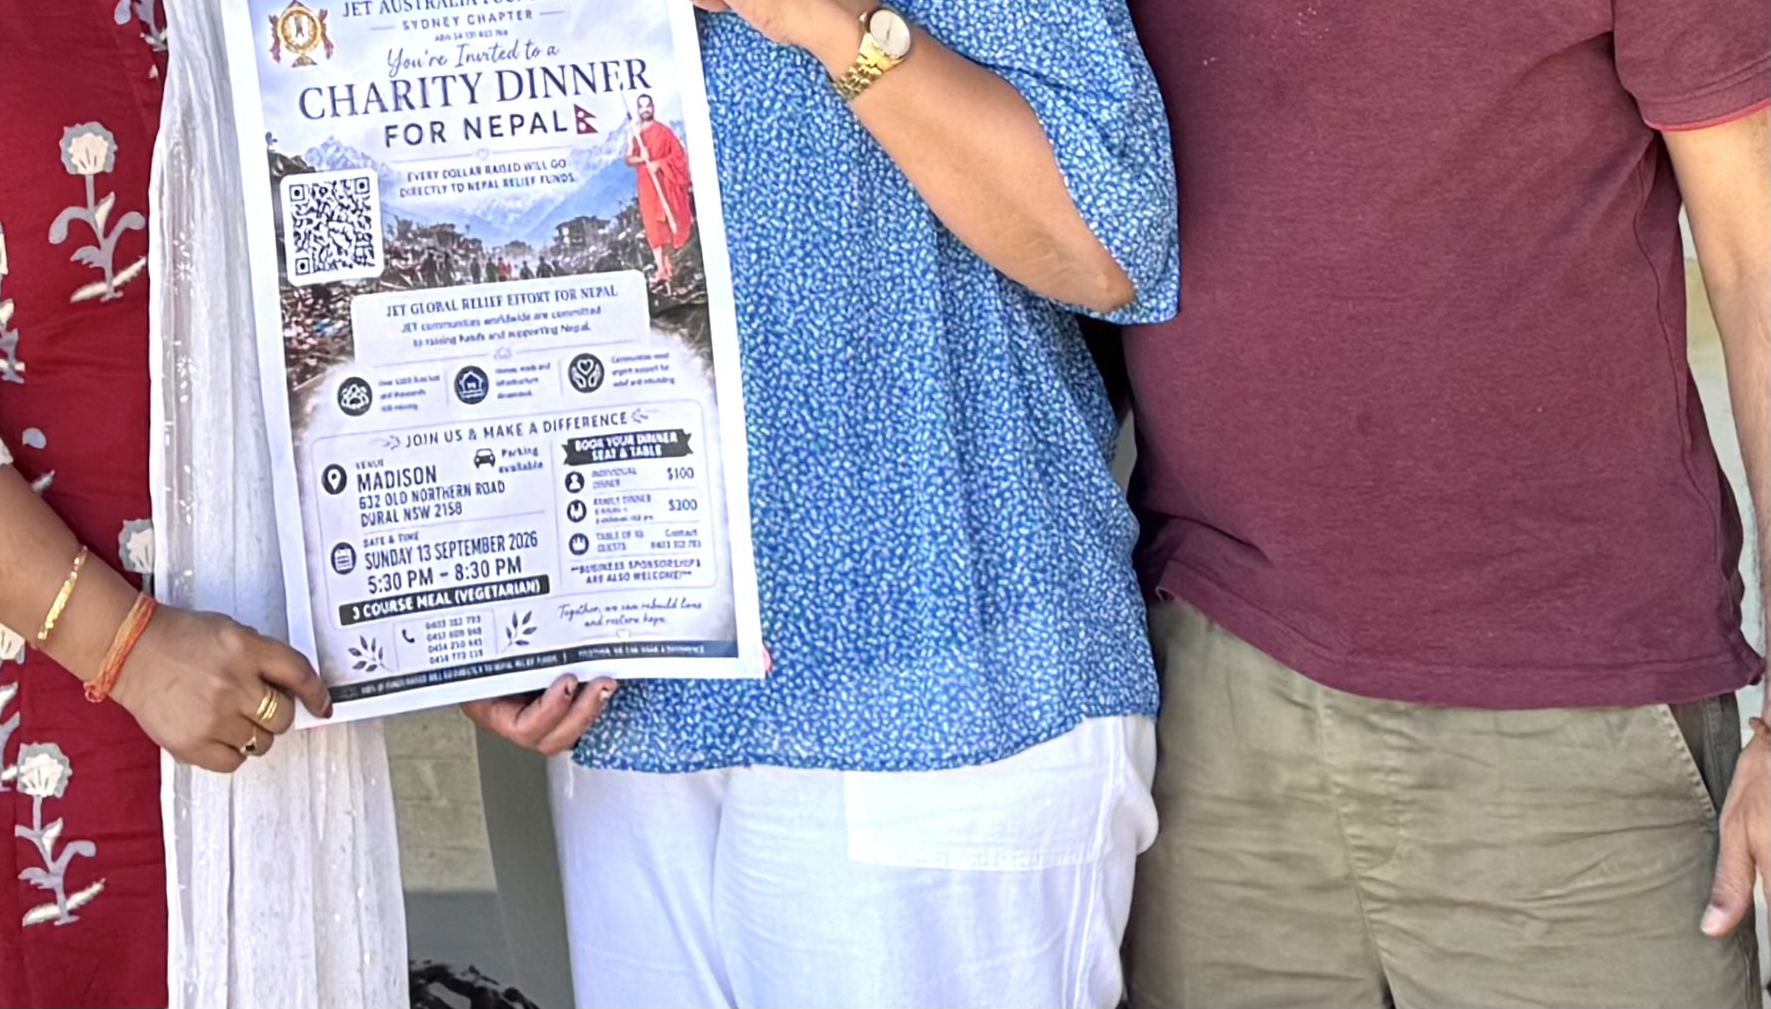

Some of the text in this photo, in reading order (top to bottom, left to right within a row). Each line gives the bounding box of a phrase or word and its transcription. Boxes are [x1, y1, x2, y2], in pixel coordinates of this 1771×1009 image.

[342, 0, 373, 18] JET
[402, 9, 533, 31] SYDNEY CHAPTER
[387, 38, 560, 77] You're Invited to a
[298, 58, 653, 121] CHARITY DINNER
[385, 109, 569, 148] FOR NEPAL
[407, 158, 566, 183] EVERY DOLLAR RAISED WILL GO
[400, 184, 448, 199] DIRECTLY
[451, 182, 463, 194] TO
[467, 178, 500, 193] NEPAL
[502, 175, 536, 189] RELIEF
[386, 285, 617, 318] JET GLOBAL RELIEF EFFORT FOR NEPAL
[406, 411, 628, 448] JOIN US & MAKE A DIFFERENCE
[502, 447, 539, 459] Parking
[357, 465, 438, 493] MADISON
[667, 467, 694, 480] $100
[359, 480, 505, 509] 632 OLD NORTHERN ROAD
[360, 501, 463, 528] DURAL NSW 2158
[365, 531, 538, 570] SUNDAY 13 SEPTEMBER 2026
[367, 573, 402, 594] 5:30
[407, 568, 434, 588] PM
[454, 560, 490, 581] 8:30
[495, 556, 522, 576] PM
[352, 579, 541, 620] 3 COURSE MEAL (VEGETARIAN)
